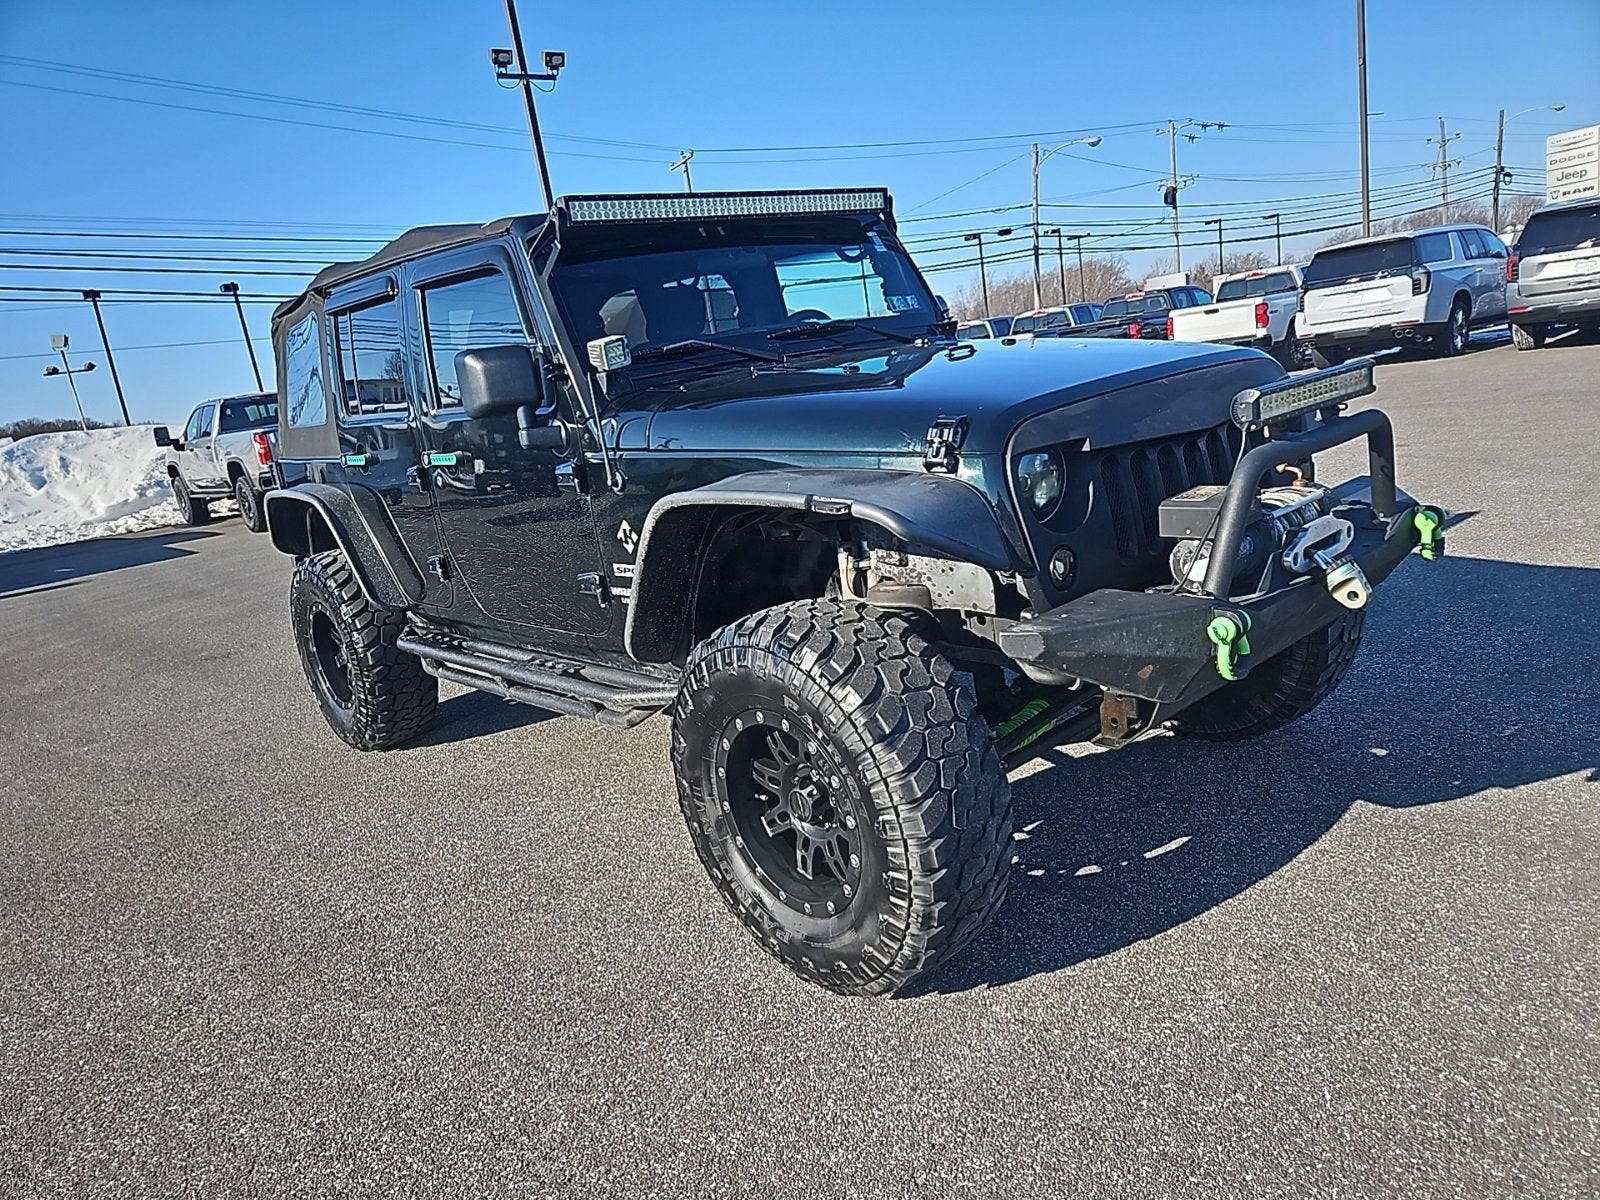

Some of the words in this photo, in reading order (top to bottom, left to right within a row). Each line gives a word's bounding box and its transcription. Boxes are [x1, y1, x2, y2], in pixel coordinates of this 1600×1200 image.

[1550, 151, 1595, 165] DODGE
[1556, 169, 1588, 182] Jeep
[1562, 185, 1595, 197] RAM
[708, 841, 792, 945] PATRIOT
